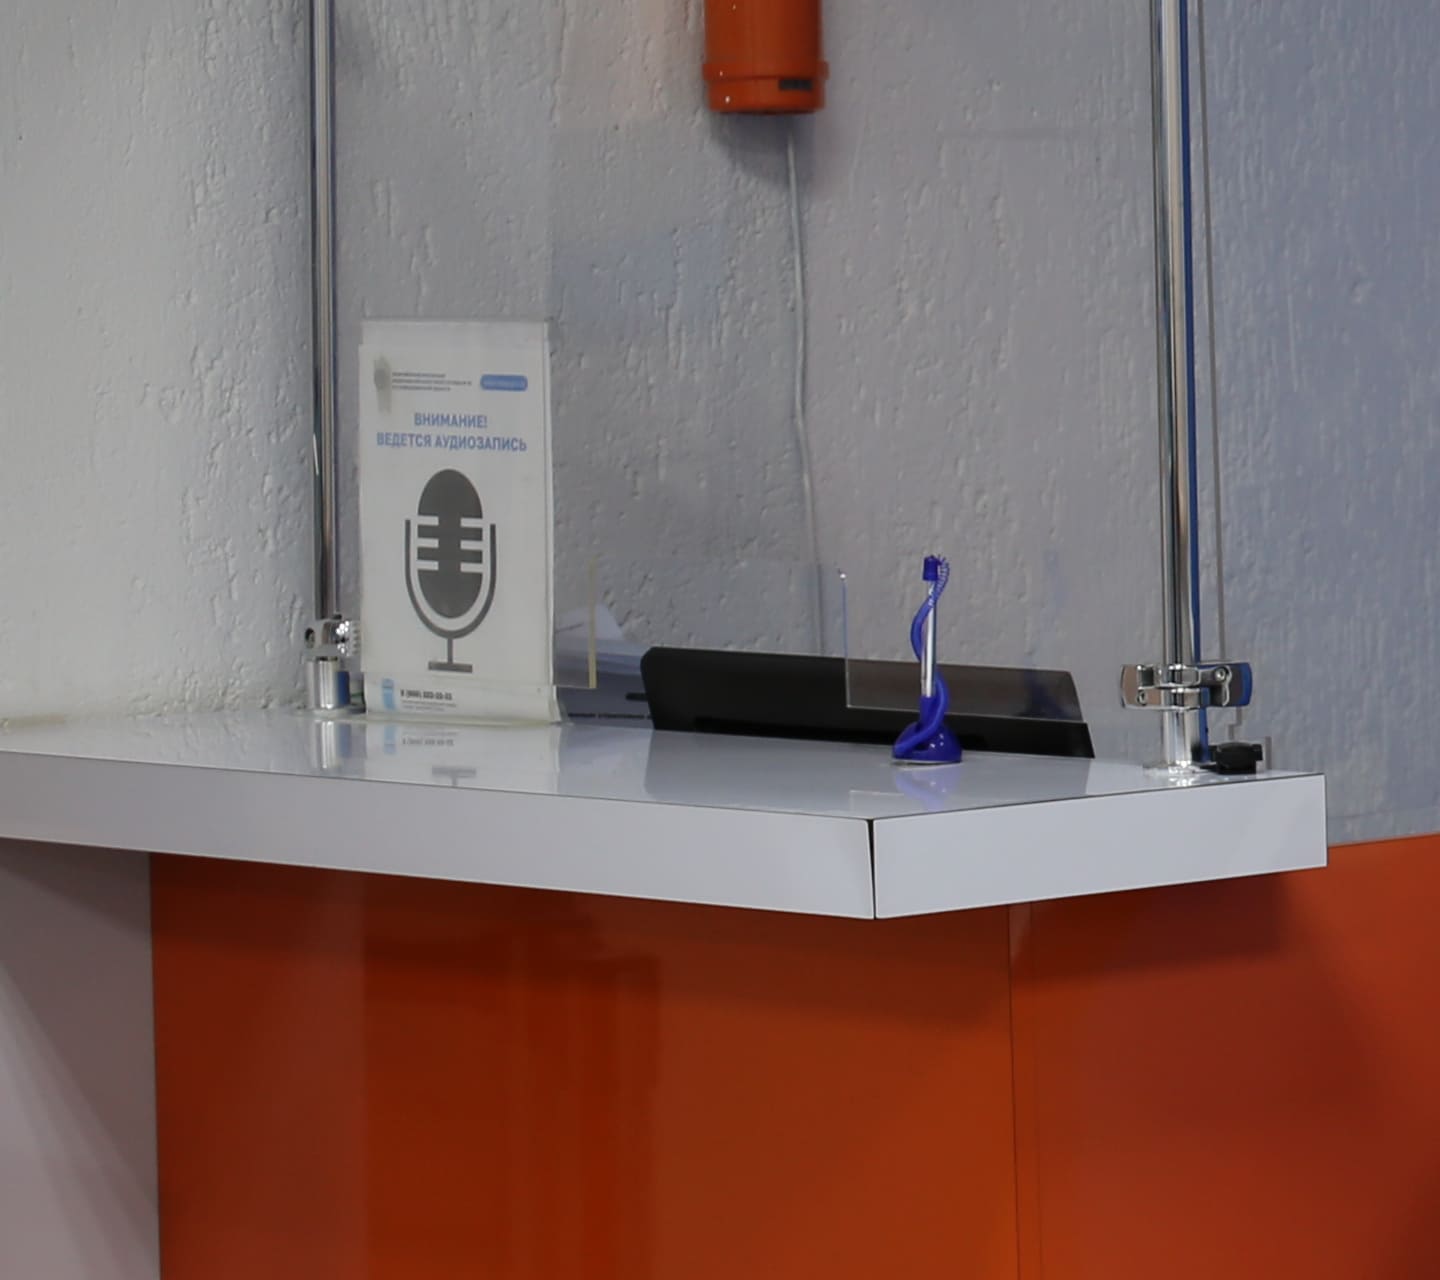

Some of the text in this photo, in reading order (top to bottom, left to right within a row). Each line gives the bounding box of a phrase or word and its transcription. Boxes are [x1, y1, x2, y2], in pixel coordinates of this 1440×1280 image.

[413, 412, 488, 428] ВНИМАНИЕ!
[376, 431, 528, 452] ВЕДЕТСЯ АУДИОЗАПИСЬ
